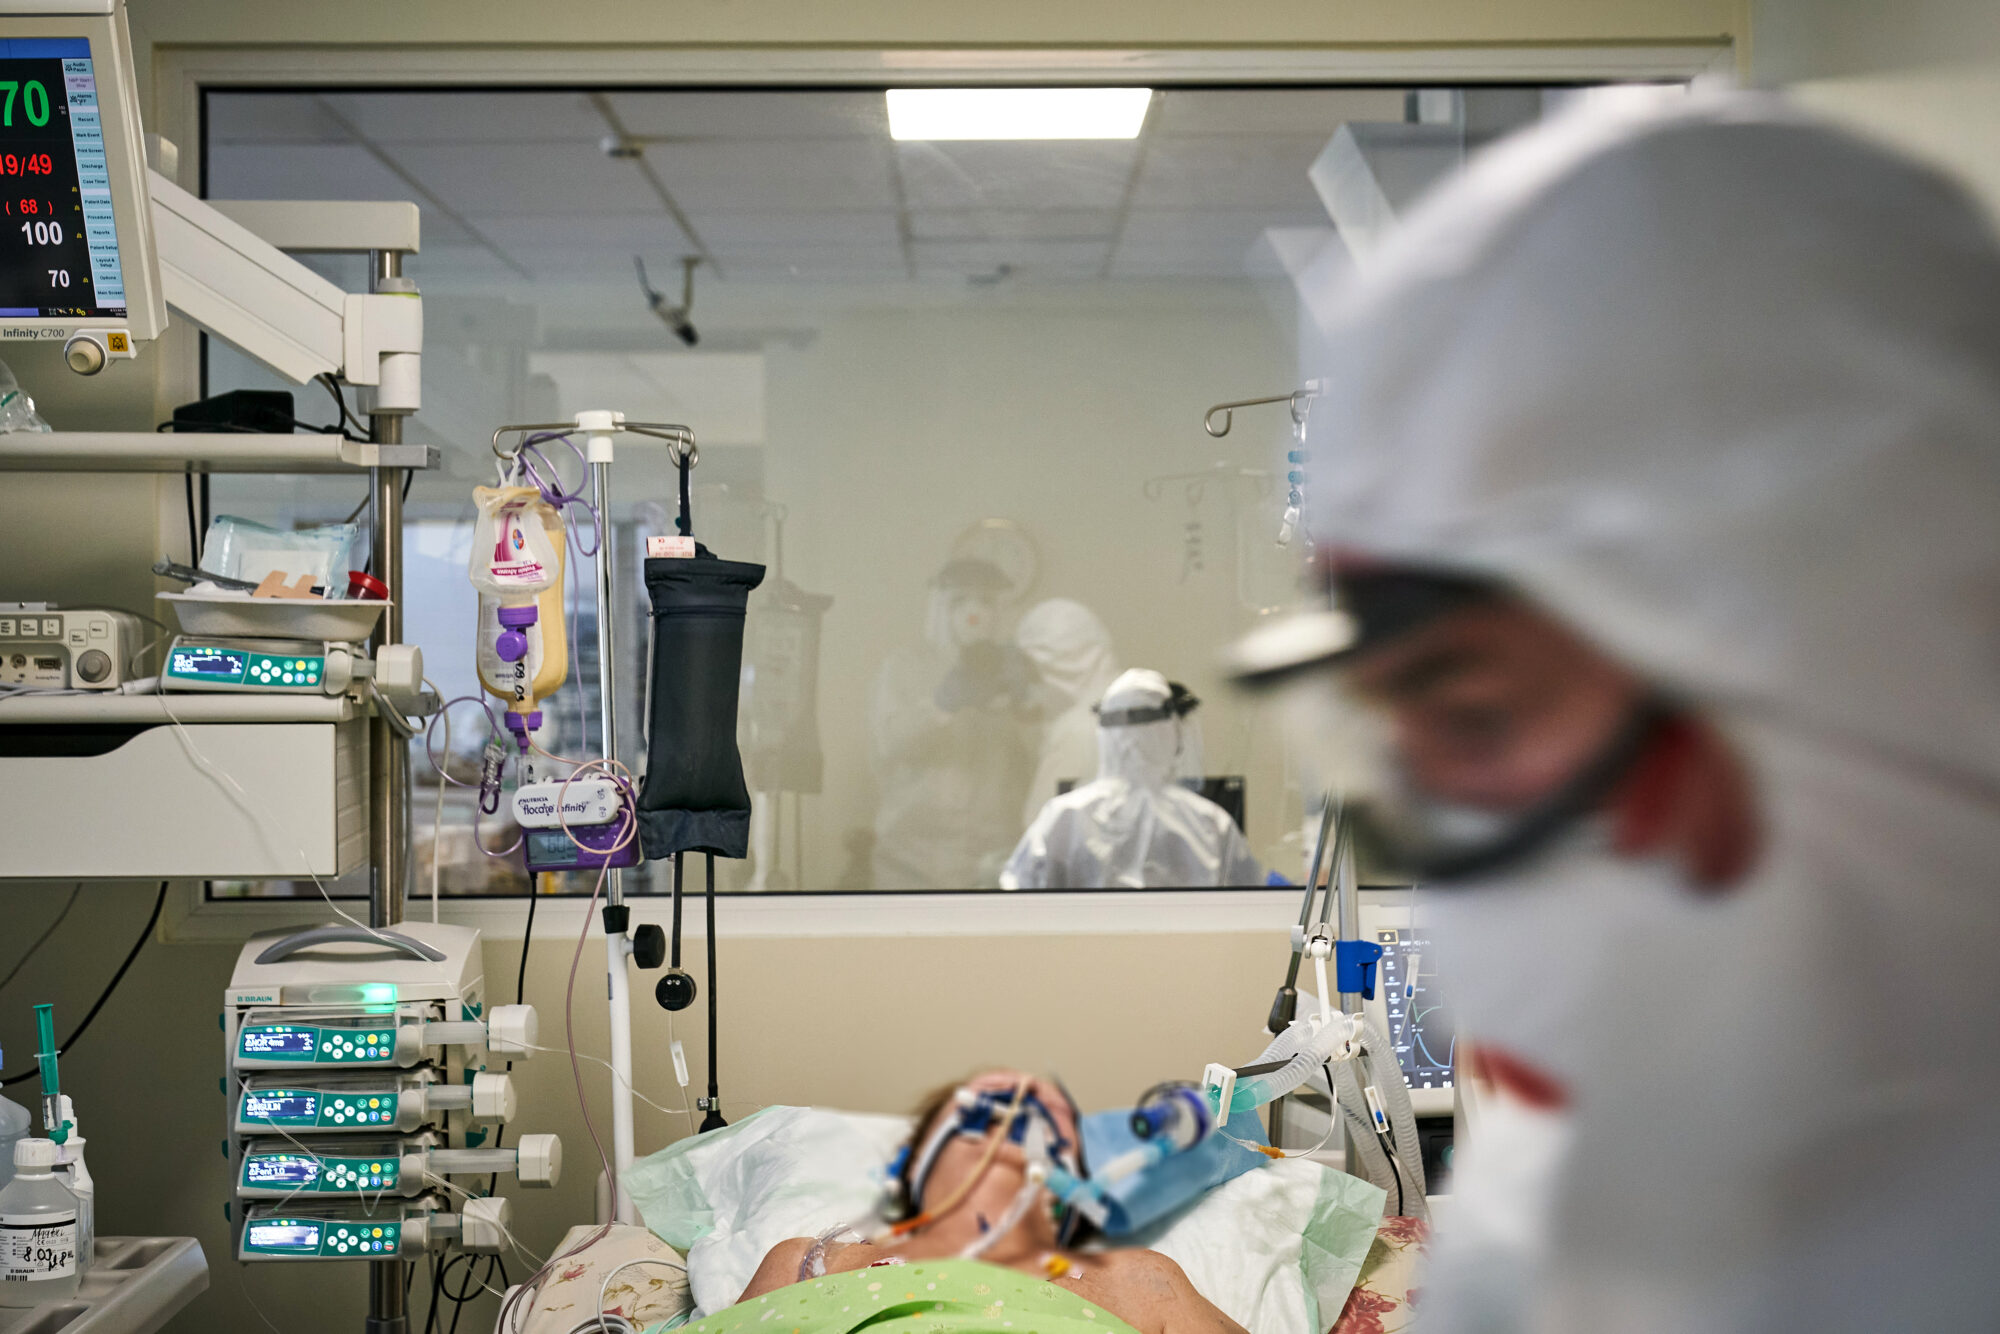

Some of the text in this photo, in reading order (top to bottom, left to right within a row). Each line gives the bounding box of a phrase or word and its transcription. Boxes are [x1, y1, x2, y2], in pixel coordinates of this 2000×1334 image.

[0, 80, 50, 127] 70
[20, 199, 38, 214] 68
[21, 221, 63, 245] 100
[48, 269, 70, 288] 70
[3, 329, 65, 339] Infinity C700
